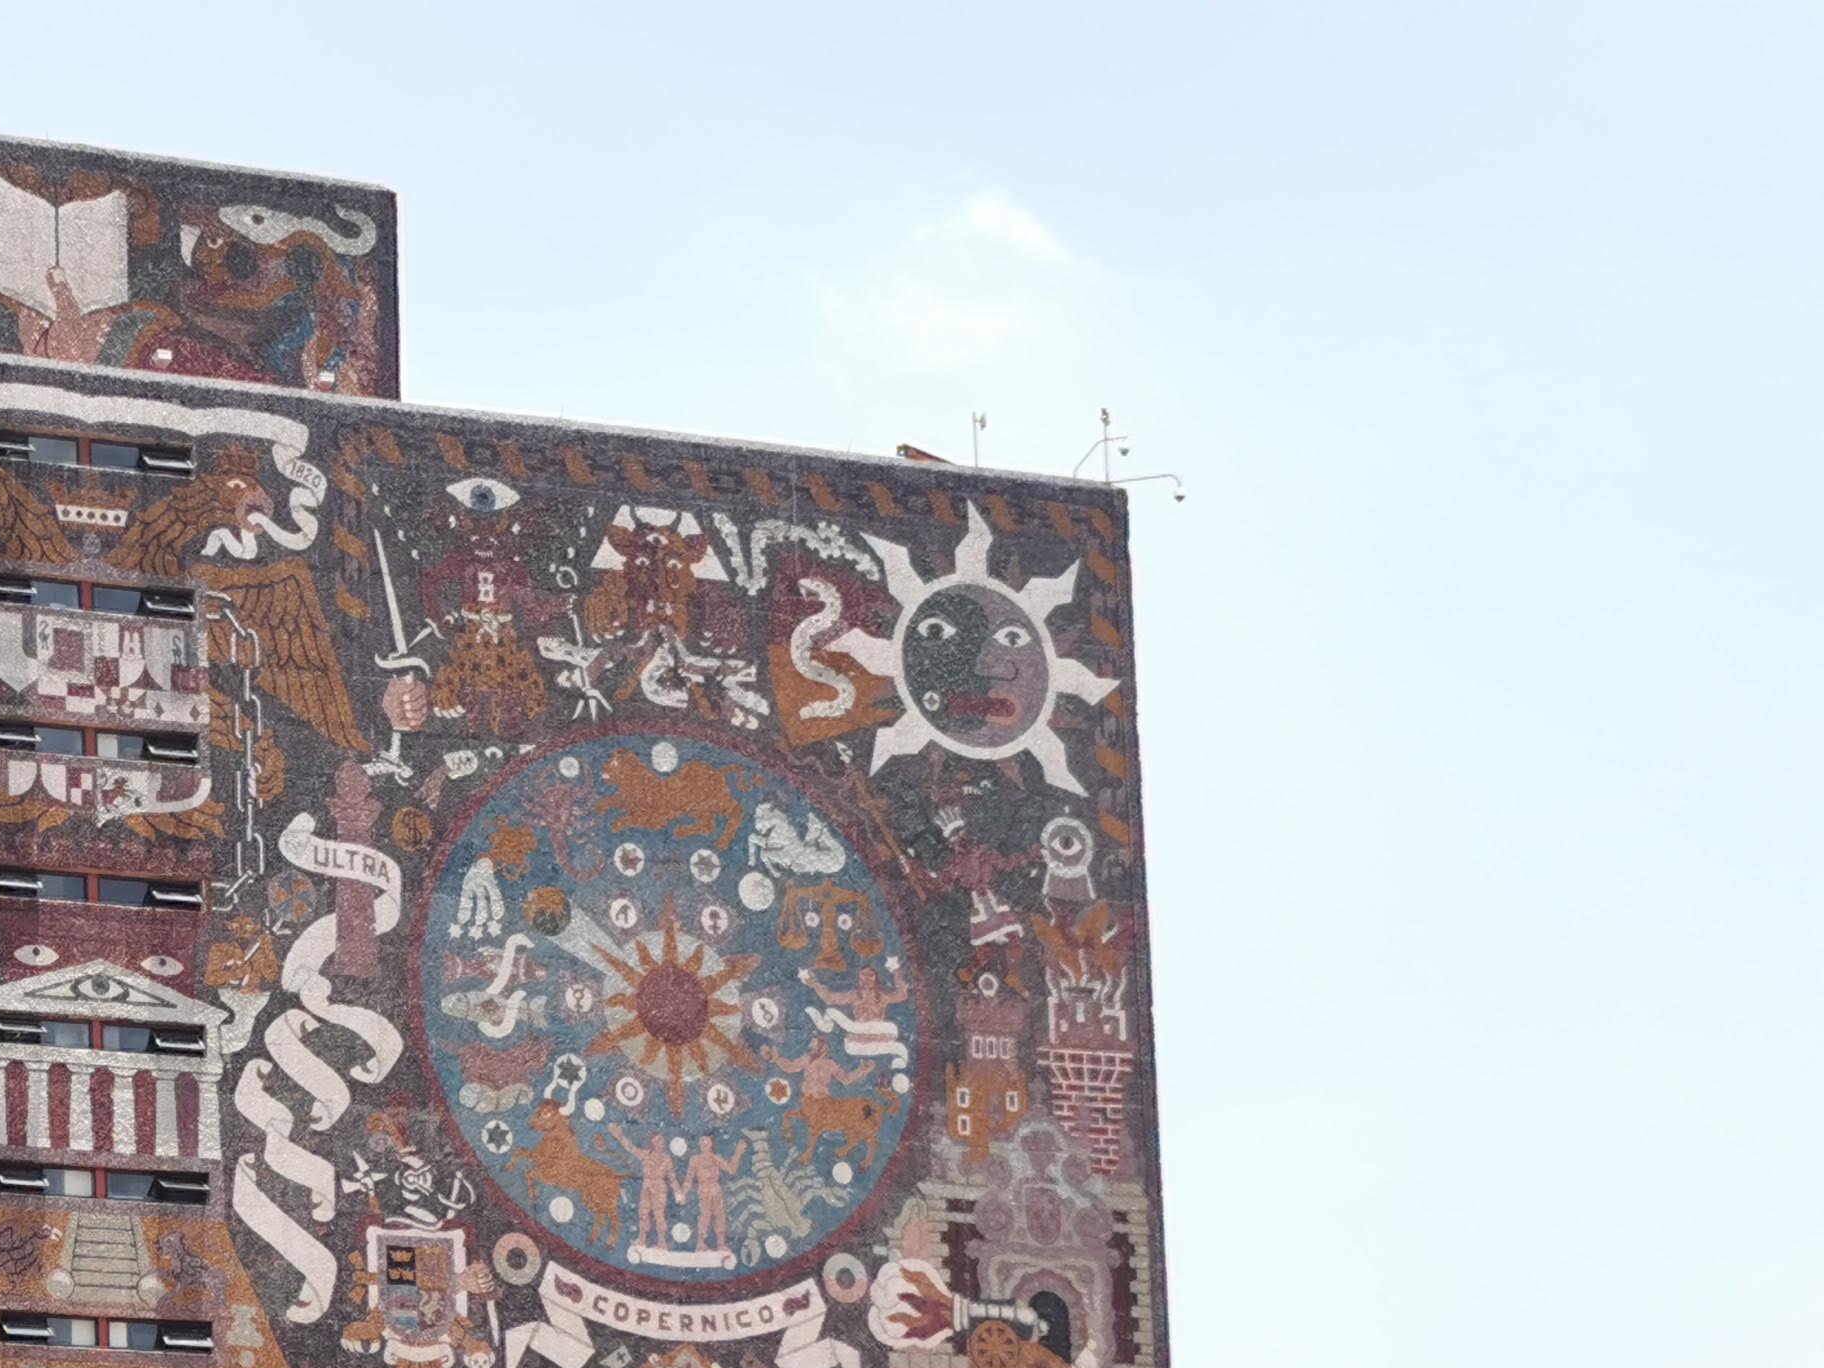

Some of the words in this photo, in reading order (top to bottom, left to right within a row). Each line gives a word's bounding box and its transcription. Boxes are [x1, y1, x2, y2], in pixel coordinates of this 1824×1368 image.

[289, 462, 322, 489] 1820
[313, 845, 390, 884] ULTRA
[592, 1294, 775, 1332] COPERNICO
